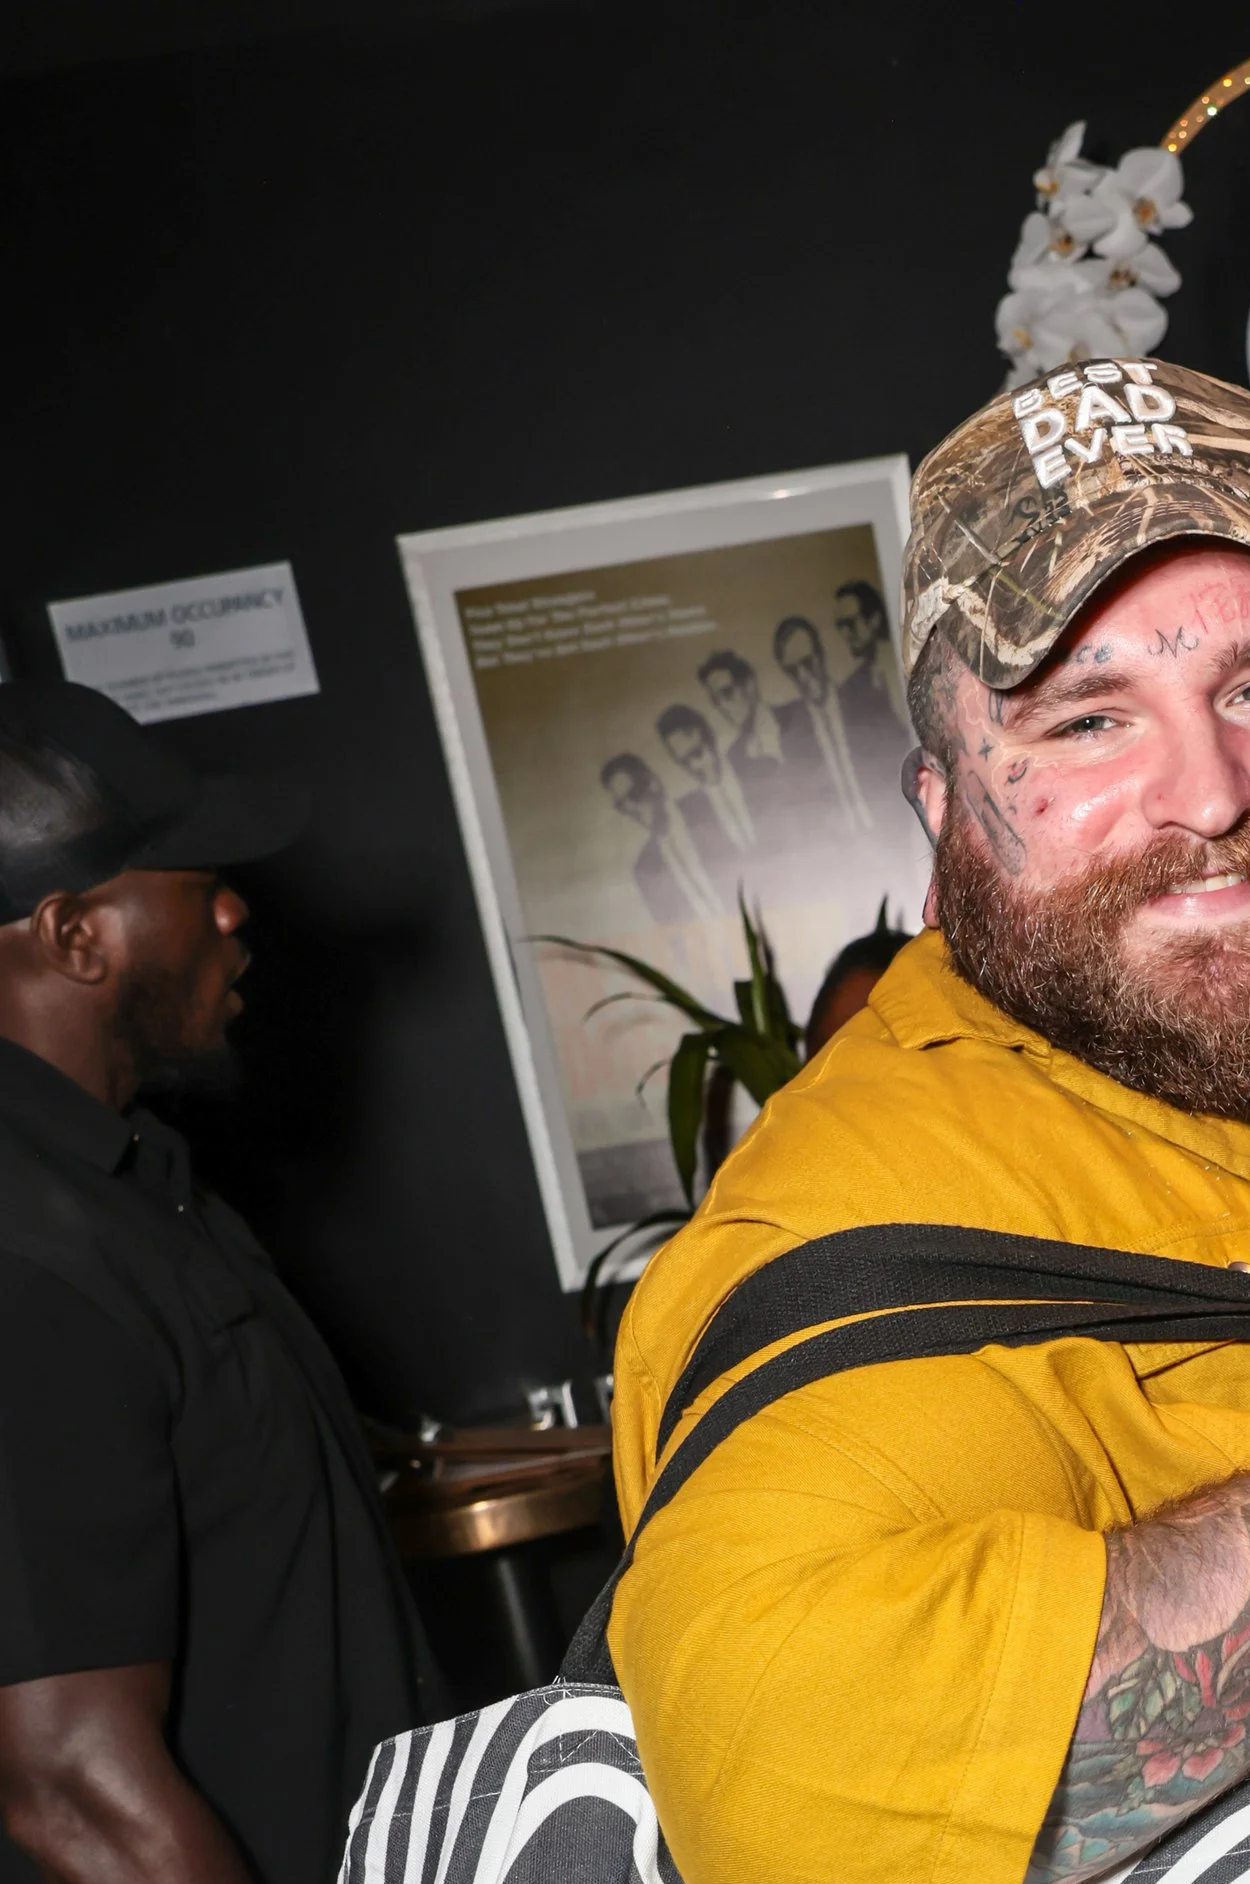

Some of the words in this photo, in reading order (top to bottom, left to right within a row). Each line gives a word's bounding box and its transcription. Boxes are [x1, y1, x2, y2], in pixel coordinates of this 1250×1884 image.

[1012, 361, 1158, 420] BEST
[1019, 382, 1177, 455] DAD
[1030, 423, 1194, 490] EVER
[65, 610, 168, 642] MAXIMUM
[170, 590, 285, 624] OCCUPANCY
